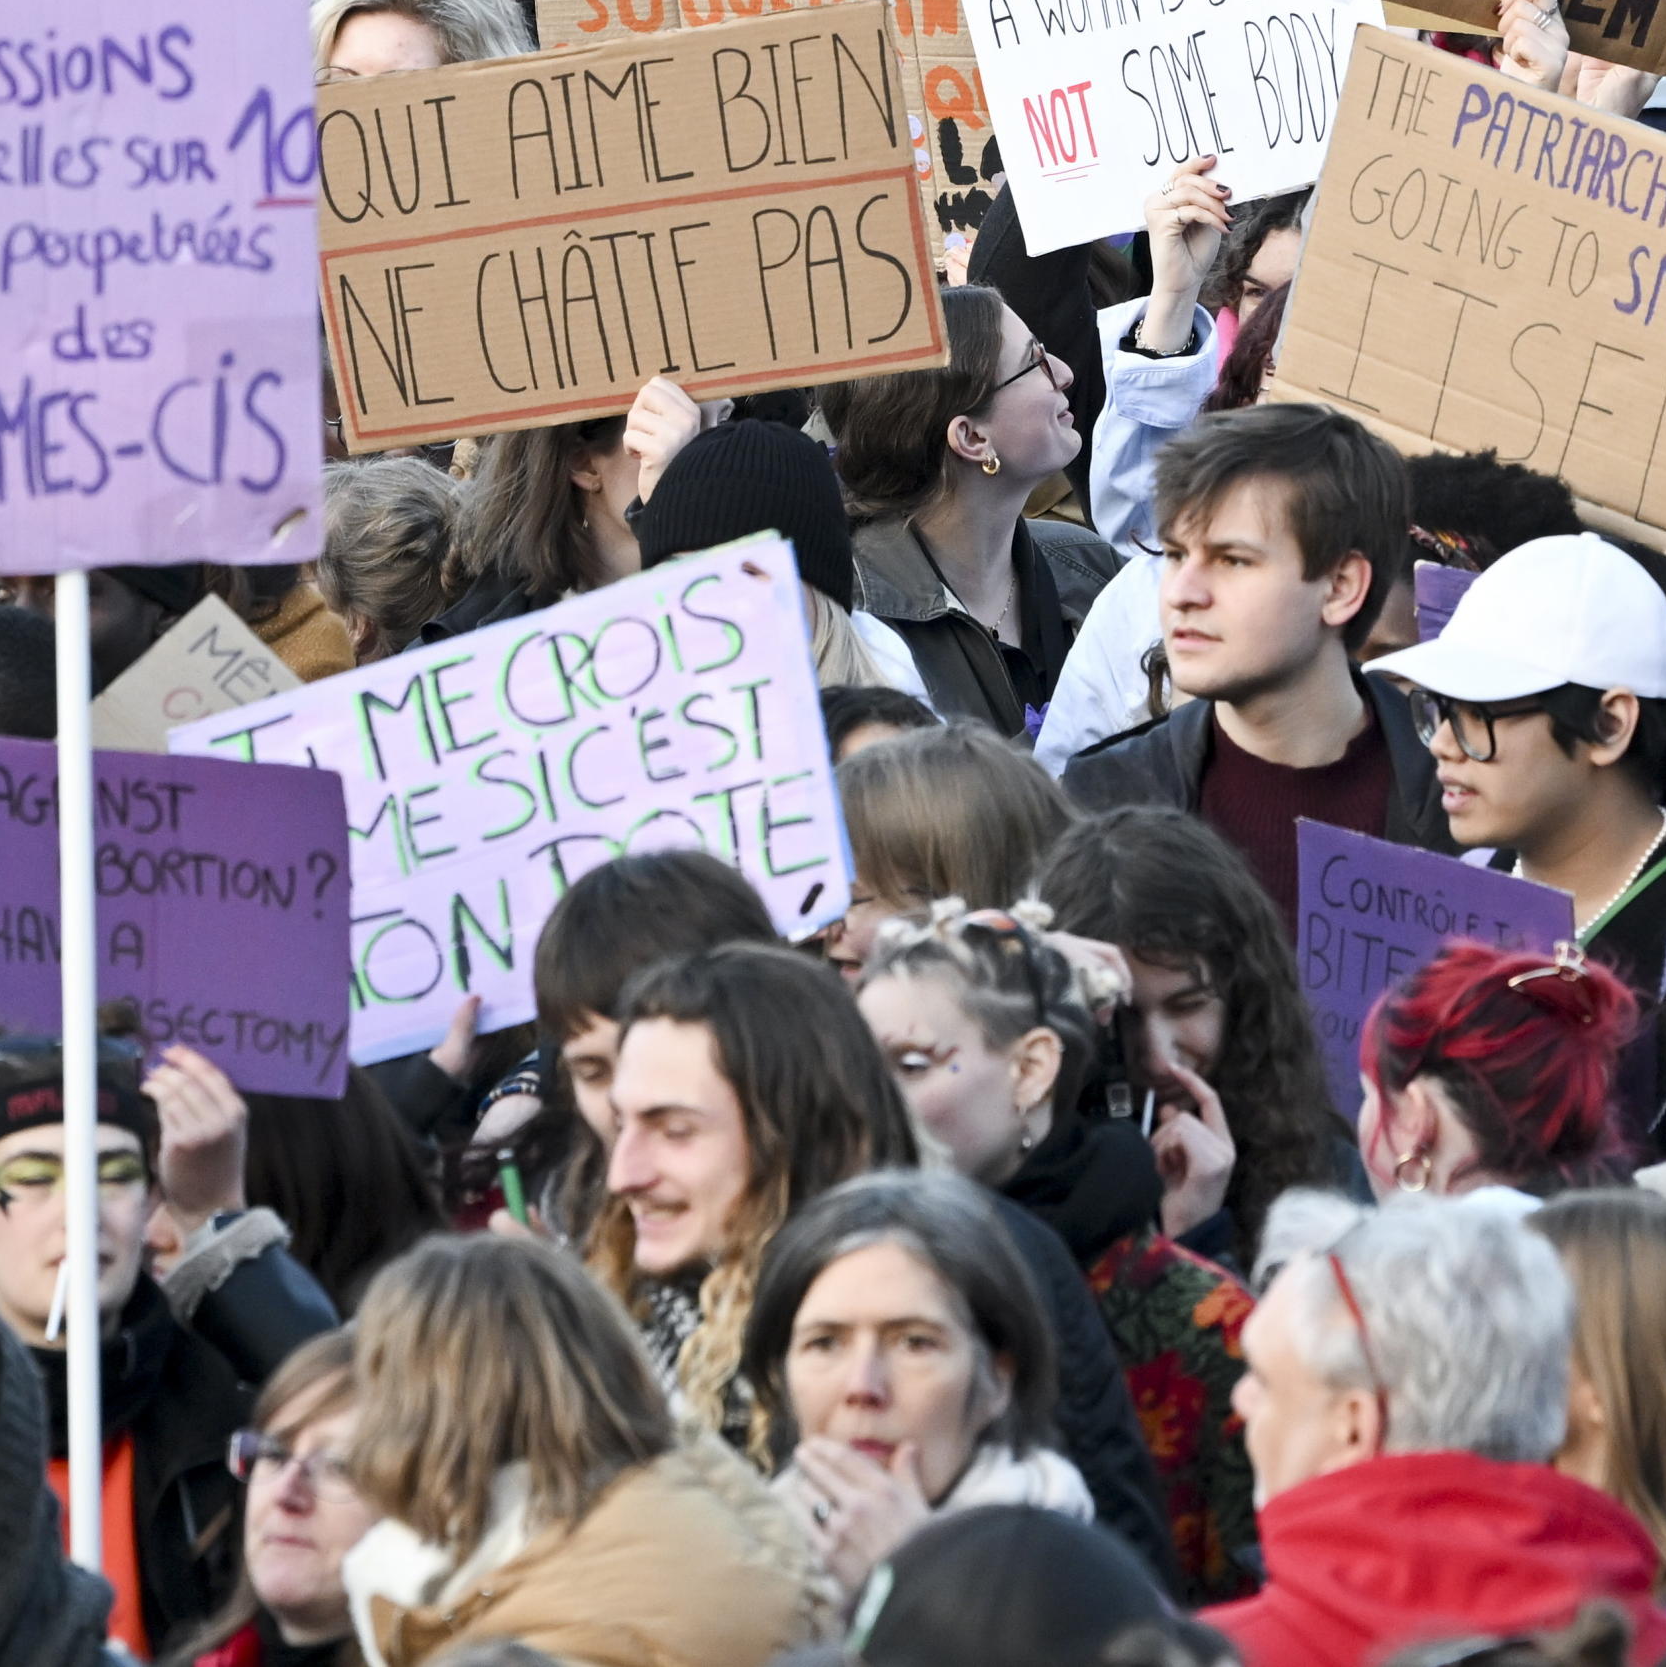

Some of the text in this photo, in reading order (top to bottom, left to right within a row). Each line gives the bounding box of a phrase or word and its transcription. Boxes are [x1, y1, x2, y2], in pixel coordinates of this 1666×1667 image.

[316, 27, 900, 224] QUI AIME BIEN
[1022, 8, 1341, 170] NOT SOME BODY
[1365, 45, 1442, 137] THE
[124, 137, 220, 190] SUR
[227, 85, 317, 198] 10
[1348, 152, 1529, 272] GOING
[1546, 215, 1600, 298] TO
[51, 304, 155, 362] des
[338, 193, 914, 417] NE CHÂTIE PAS
[353, 653, 498, 783] ME
[94, 840, 339, 921] BORTION?
[1320, 854, 1481, 936] CONTRÔLE
[108, 919, 146, 973] A
[128, 994, 347, 1088] SECTOMY
